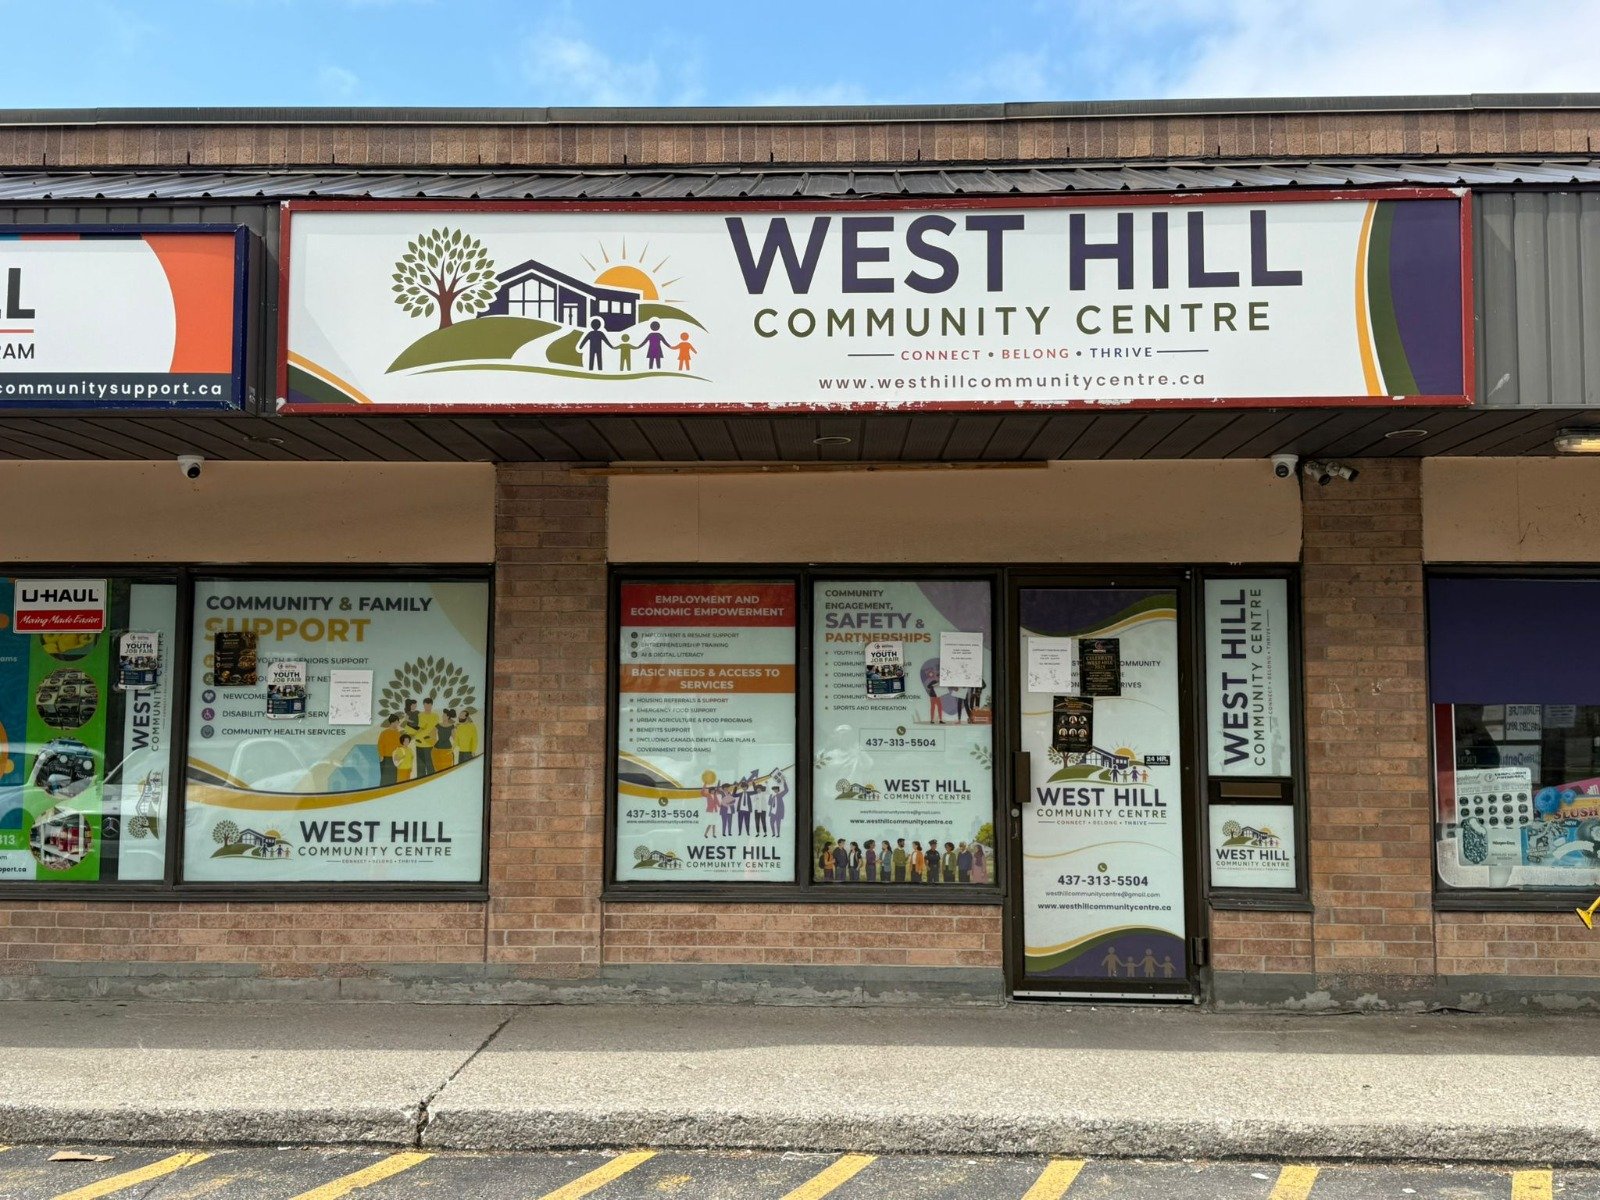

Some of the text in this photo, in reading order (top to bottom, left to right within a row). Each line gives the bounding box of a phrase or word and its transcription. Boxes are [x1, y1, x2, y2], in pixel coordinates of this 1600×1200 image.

[725, 210, 1302, 294] WEST HILL
[0, 268, 35, 319] L
[754, 302, 1269, 338] COMMUNITY CENTRE
[0, 343, 34, 359] AM
[901, 346, 1152, 360] CONNECT BELONG THRIVE
[819, 373, 1205, 390] www.westhillcommunitycentre.ca
[22, 589, 98, 602] U-HAUL
[655, 596, 760, 604] EMPLOYMENT AND
[206, 596, 433, 611] COMMUNITY & FAMILY
[631, 608, 784, 616] ECONOMIC EMPOWERMENT
[20, 615, 48, 626] Moving
[49, 615, 73, 624] Made
[825, 613, 924, 628] SAFETY &
[204, 617, 371, 642] SUPPORT
[825, 632, 932, 643] PARTNERSHIPS
[632, 668, 780, 677] BASIC NEEDS & ACCESS TO
[1220, 589, 1249, 766] WEST HILL
[1250, 589, 1265, 766] COMMUNITY CENTRE
[680, 681, 734, 689] SERVICES
[132, 690, 151, 750] WEST
[866, 738, 936, 747] 437-313-5504
[884, 779, 971, 793] WEST HILL
[1036, 788, 1167, 807] WEST HILL
[626, 810, 699, 818] 437-313-5504
[1037, 808, 1167, 818] COMMUNITY CENTRE
[300, 820, 452, 843] WEST HILL
[0, 835, 15, 845] 13
[298, 846, 452, 856] COMMUNITY CENTRE
[687, 846, 780, 860] WEST HILL
[1216, 849, 1289, 860] WEST HILL
[1057, 875, 1148, 886] 437-313-5504
[1038, 902, 1172, 912] www.westhillcommunitycentre.ca
